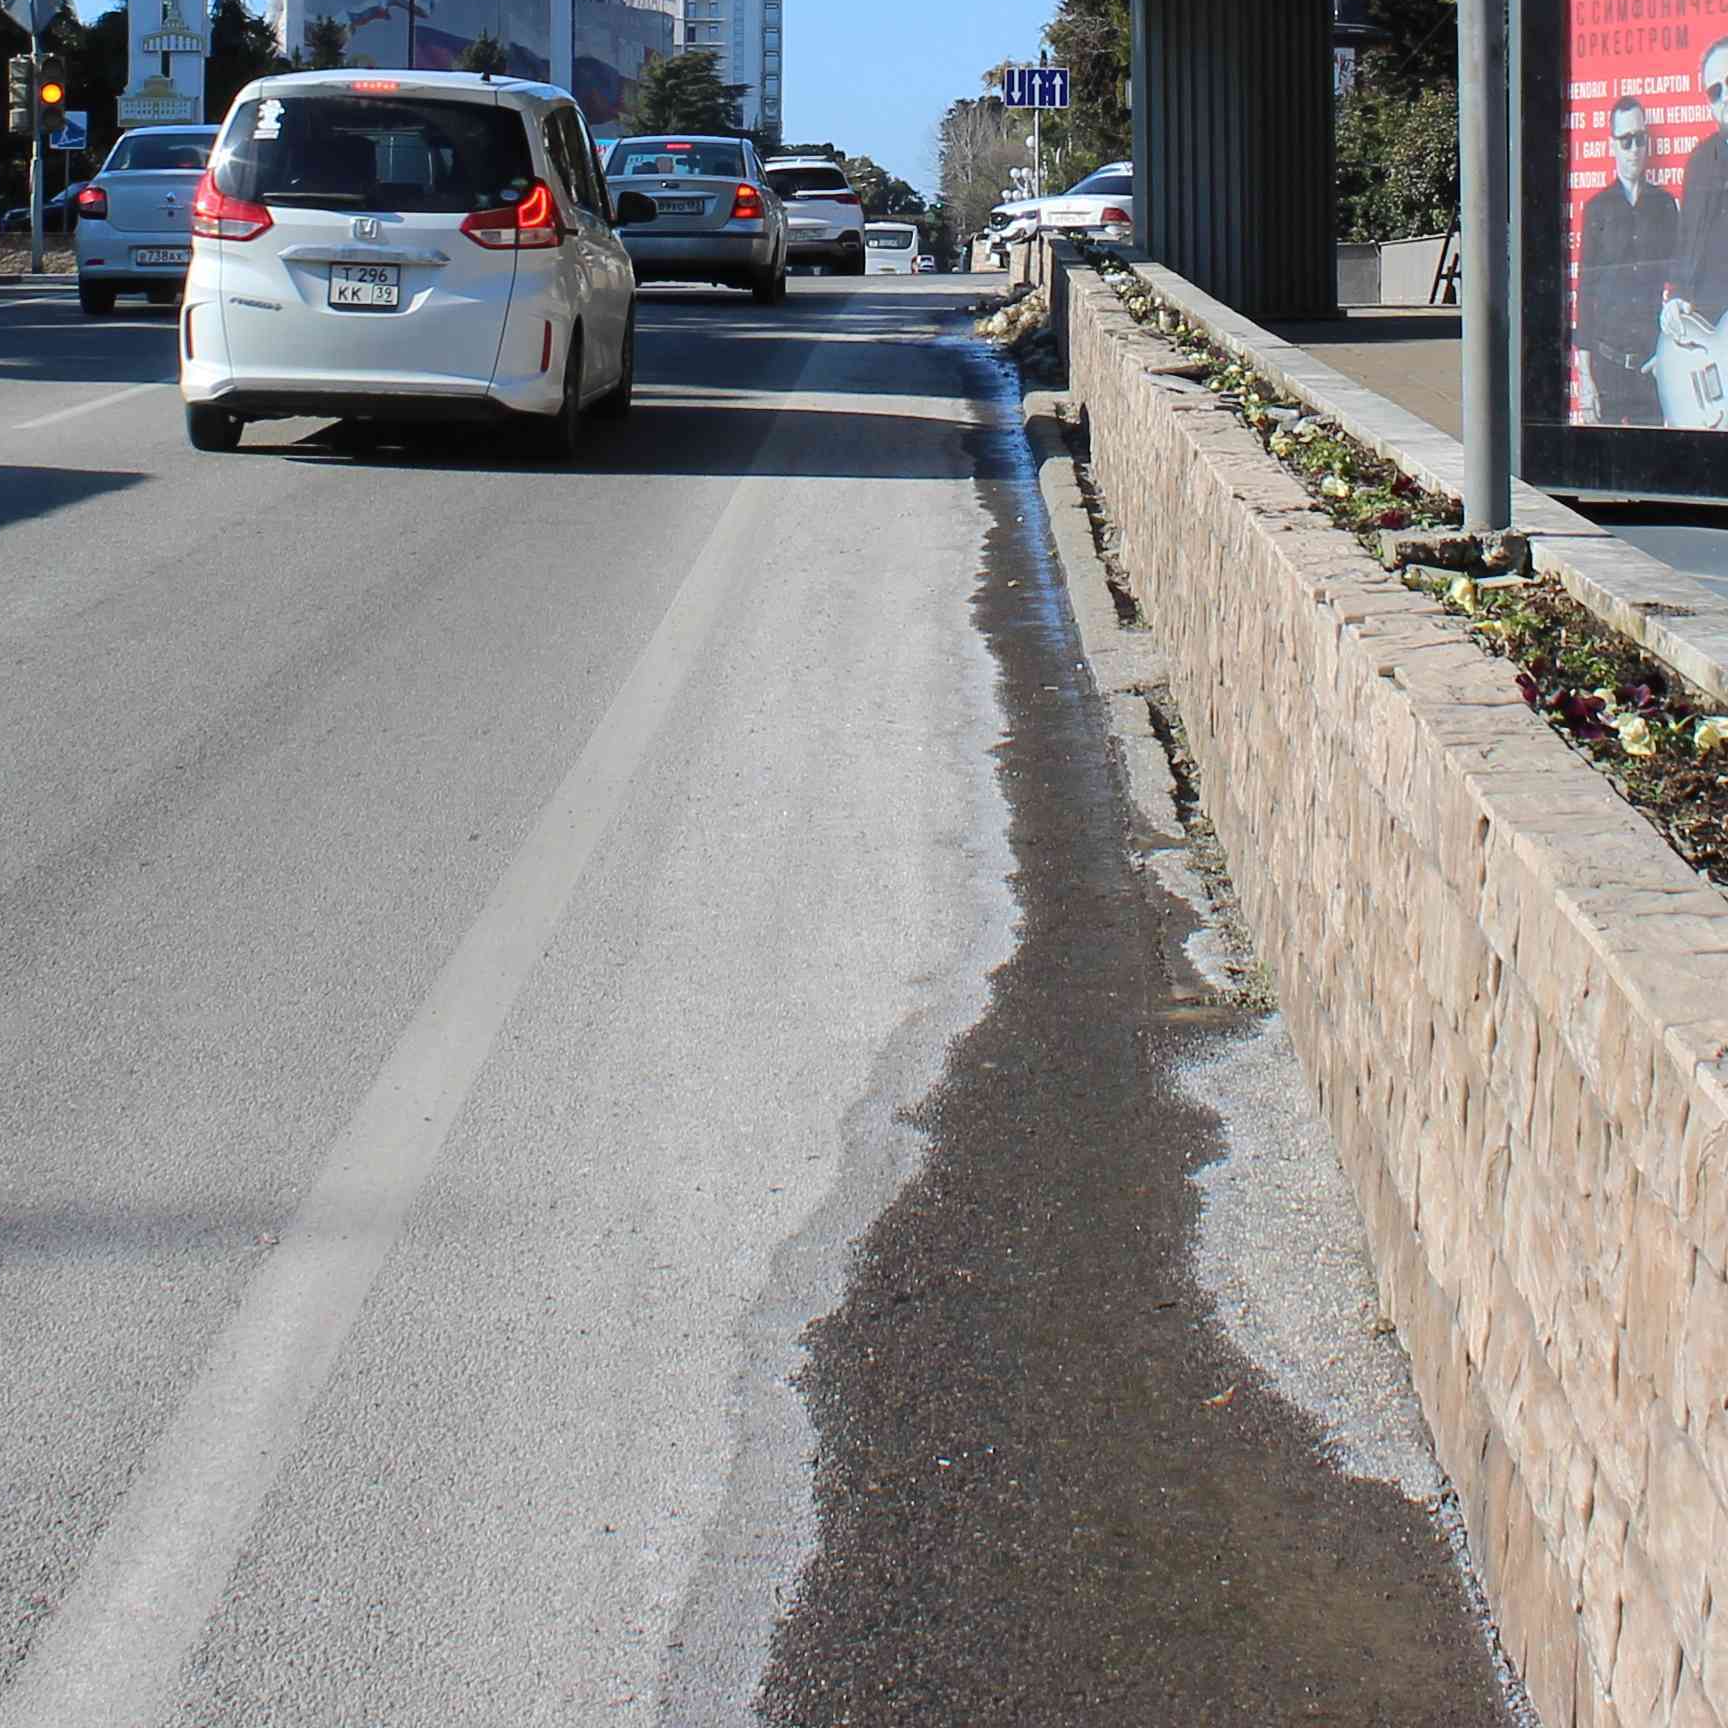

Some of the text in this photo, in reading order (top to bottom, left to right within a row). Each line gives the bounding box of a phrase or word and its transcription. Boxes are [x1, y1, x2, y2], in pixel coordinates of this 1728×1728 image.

[1576, 25, 1690, 58] ОРКЕСТРОМ
[1621, 77, 1643, 97] ERIC
[1644, 75, 1690, 95] CLAPTON
[1667, 104, 1713, 123] HENDRIX
[357, 267, 388, 282] 296
[338, 286, 392, 302] КК 39
